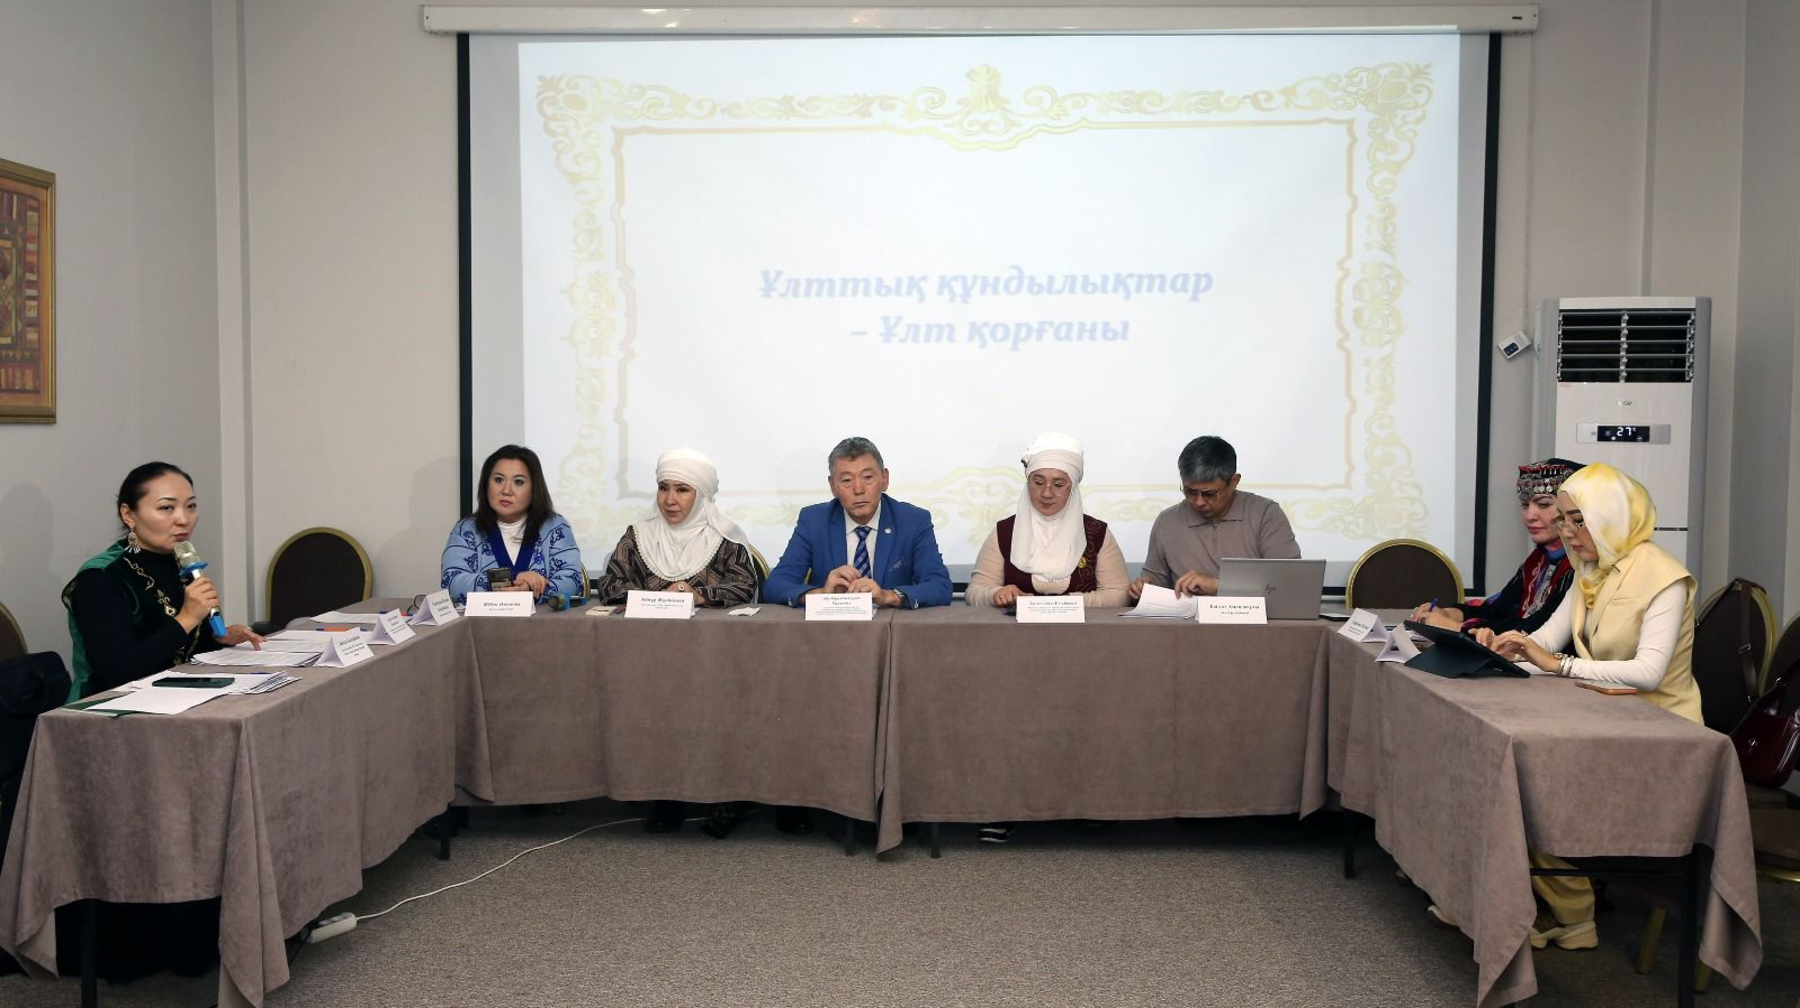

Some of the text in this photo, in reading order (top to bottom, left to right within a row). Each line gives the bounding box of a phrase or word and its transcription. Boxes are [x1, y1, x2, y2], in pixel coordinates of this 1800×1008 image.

[757, 263, 1215, 305] Ұлттық құндылықтар
[878, 315, 957, 345] Ұлт
[966, 320, 1131, 353] қорғаны
